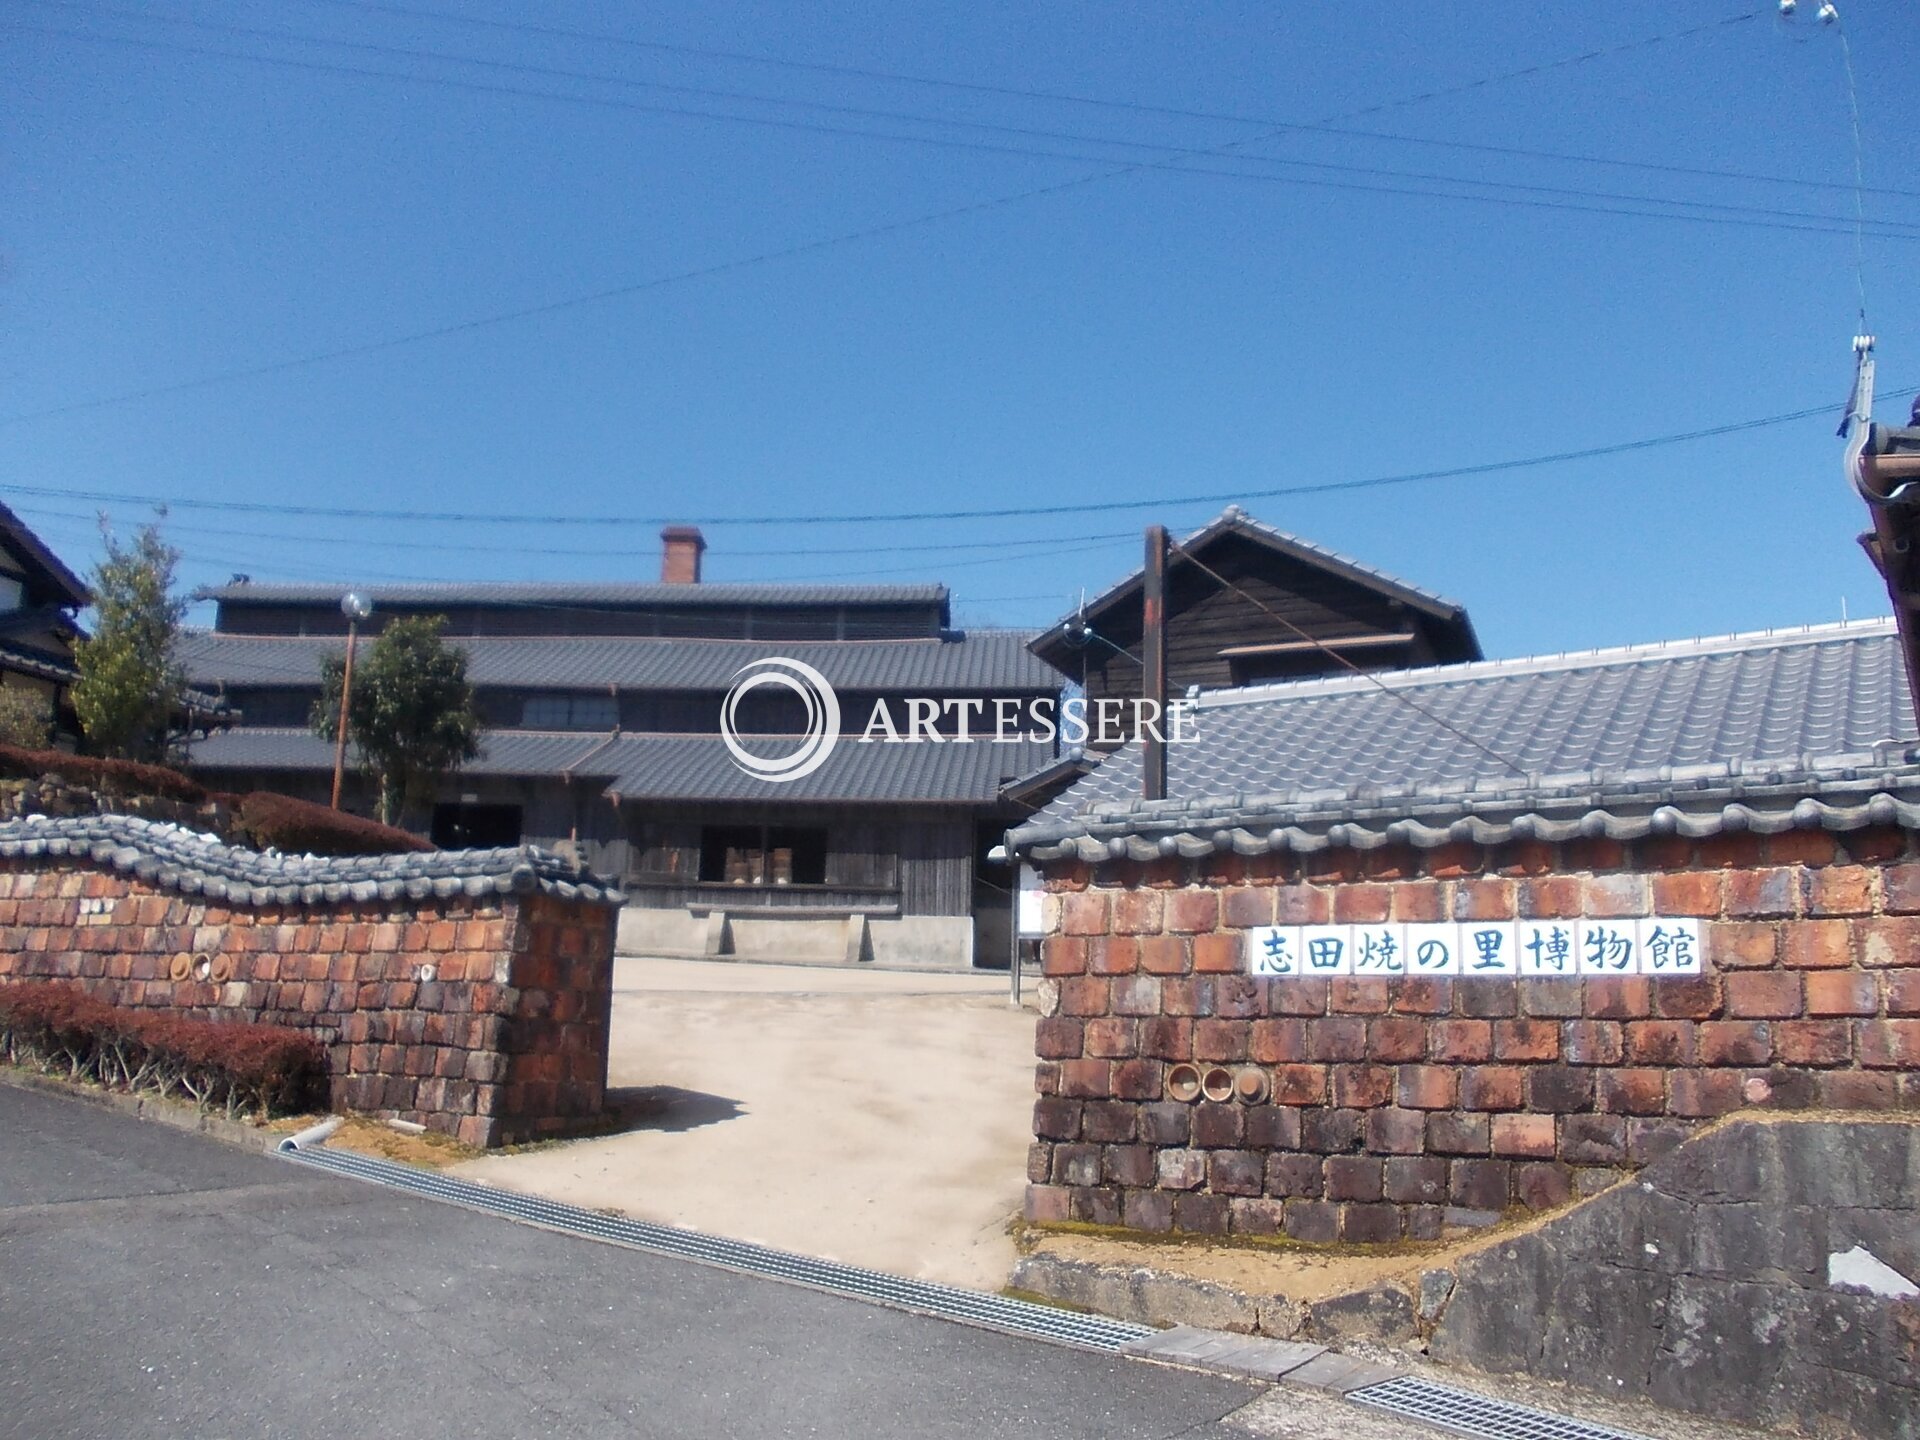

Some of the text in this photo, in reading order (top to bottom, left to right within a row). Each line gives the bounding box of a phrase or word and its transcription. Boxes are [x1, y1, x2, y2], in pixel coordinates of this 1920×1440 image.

[1259, 925, 1695, 972] 志田焼の里博物館
